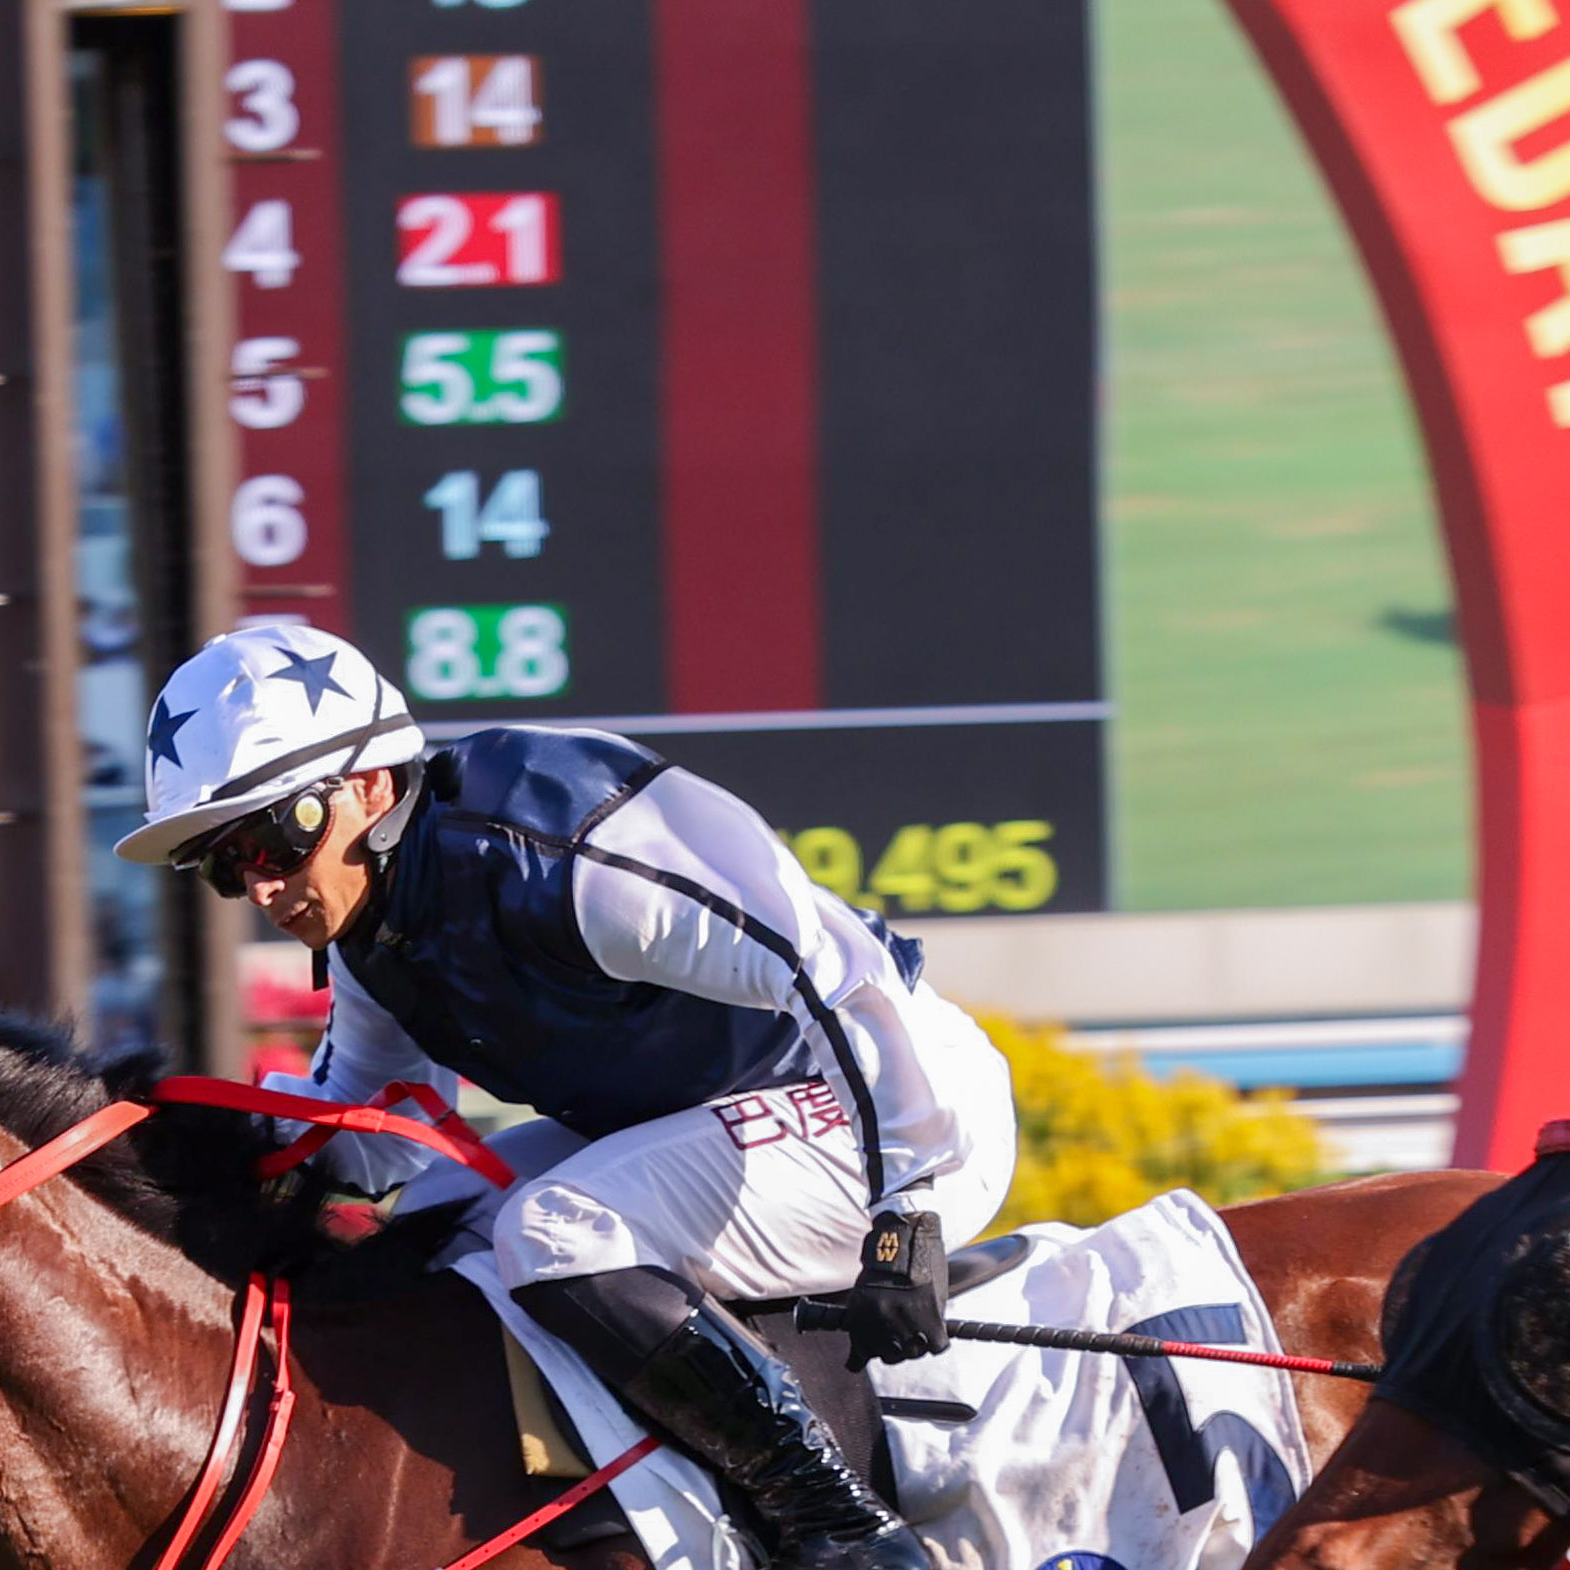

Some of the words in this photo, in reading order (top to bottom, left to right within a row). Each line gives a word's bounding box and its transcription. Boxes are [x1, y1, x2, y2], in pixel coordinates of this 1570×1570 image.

[224, 58, 300, 151] 3
[413, 54, 543, 146] 14
[222, 201, 301, 288] 4
[229, 337, 305, 429] 5
[232, 475, 308, 567] 6
[423, 469, 550, 560] 14
[407, 606, 570, 699] 8.8
